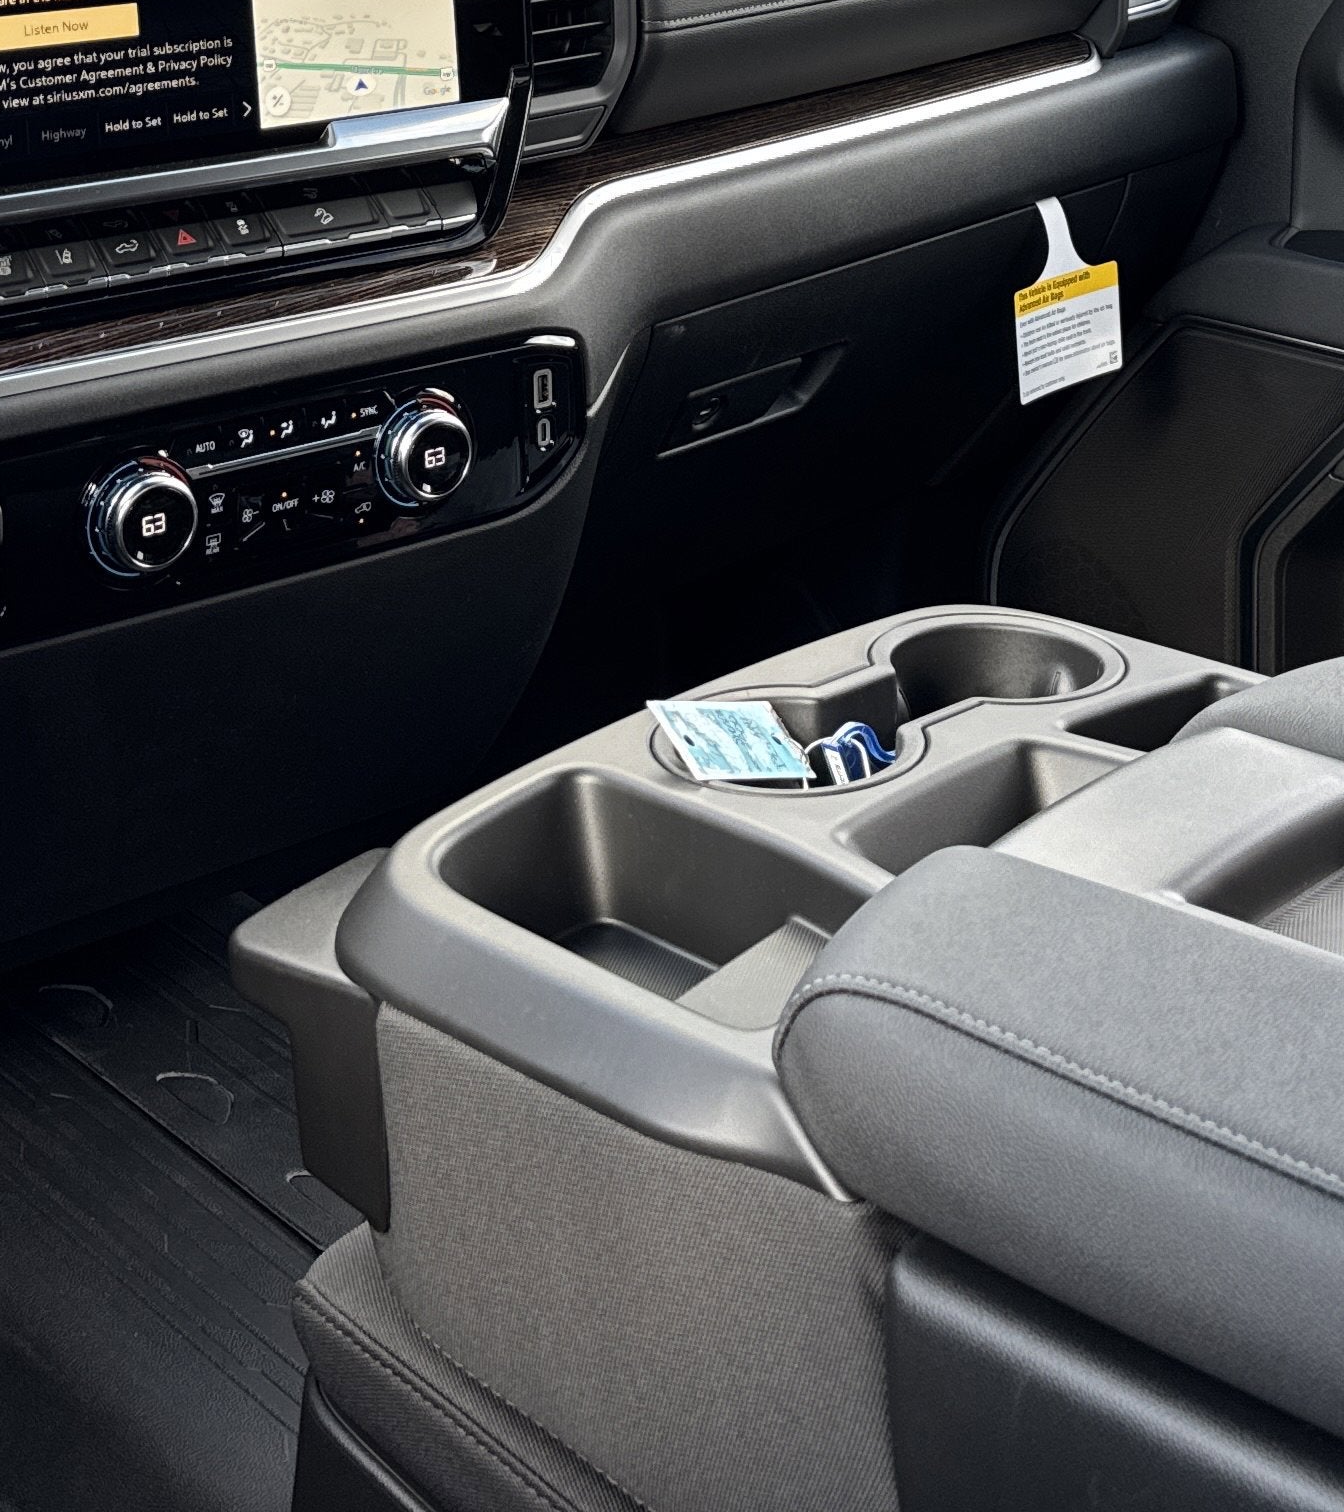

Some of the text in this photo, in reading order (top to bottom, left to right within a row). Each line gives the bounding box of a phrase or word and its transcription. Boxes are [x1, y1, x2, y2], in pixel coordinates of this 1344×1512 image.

[23, 19, 89, 37] Listen Now
[12, 60, 35, 75] you
[37, 56, 71, 71] agree
[74, 51, 97, 65] that
[100, 50, 125, 65] your
[128, 44, 150, 58] trial
[153, 39, 221, 56] subscription
[223, 36, 233, 48] is
[20, 73, 77, 90] Customer
[80, 64, 144, 84] Agreement
[146, 61, 156, 74] &
[158, 57, 197, 72] Privacy
[200, 54, 233, 68] Policy
[3, 96, 29, 109] view
[32, 94, 44, 105] at
[173, 107, 228, 123] Hold to Set
[105, 116, 162, 133] Hold to Set
[41, 127, 86, 143] Highway
[1052, 274, 1078, 290] Equipped
[1078, 271, 1091, 281] with
[359, 404, 378, 418] SYNC
[195, 440, 216, 454] AUTO
[424, 446, 446, 469] 63
[353, 460, 367, 473] A/C
[272, 497, 300, 513] ON/OFF
[141, 512, 167, 537] 63
